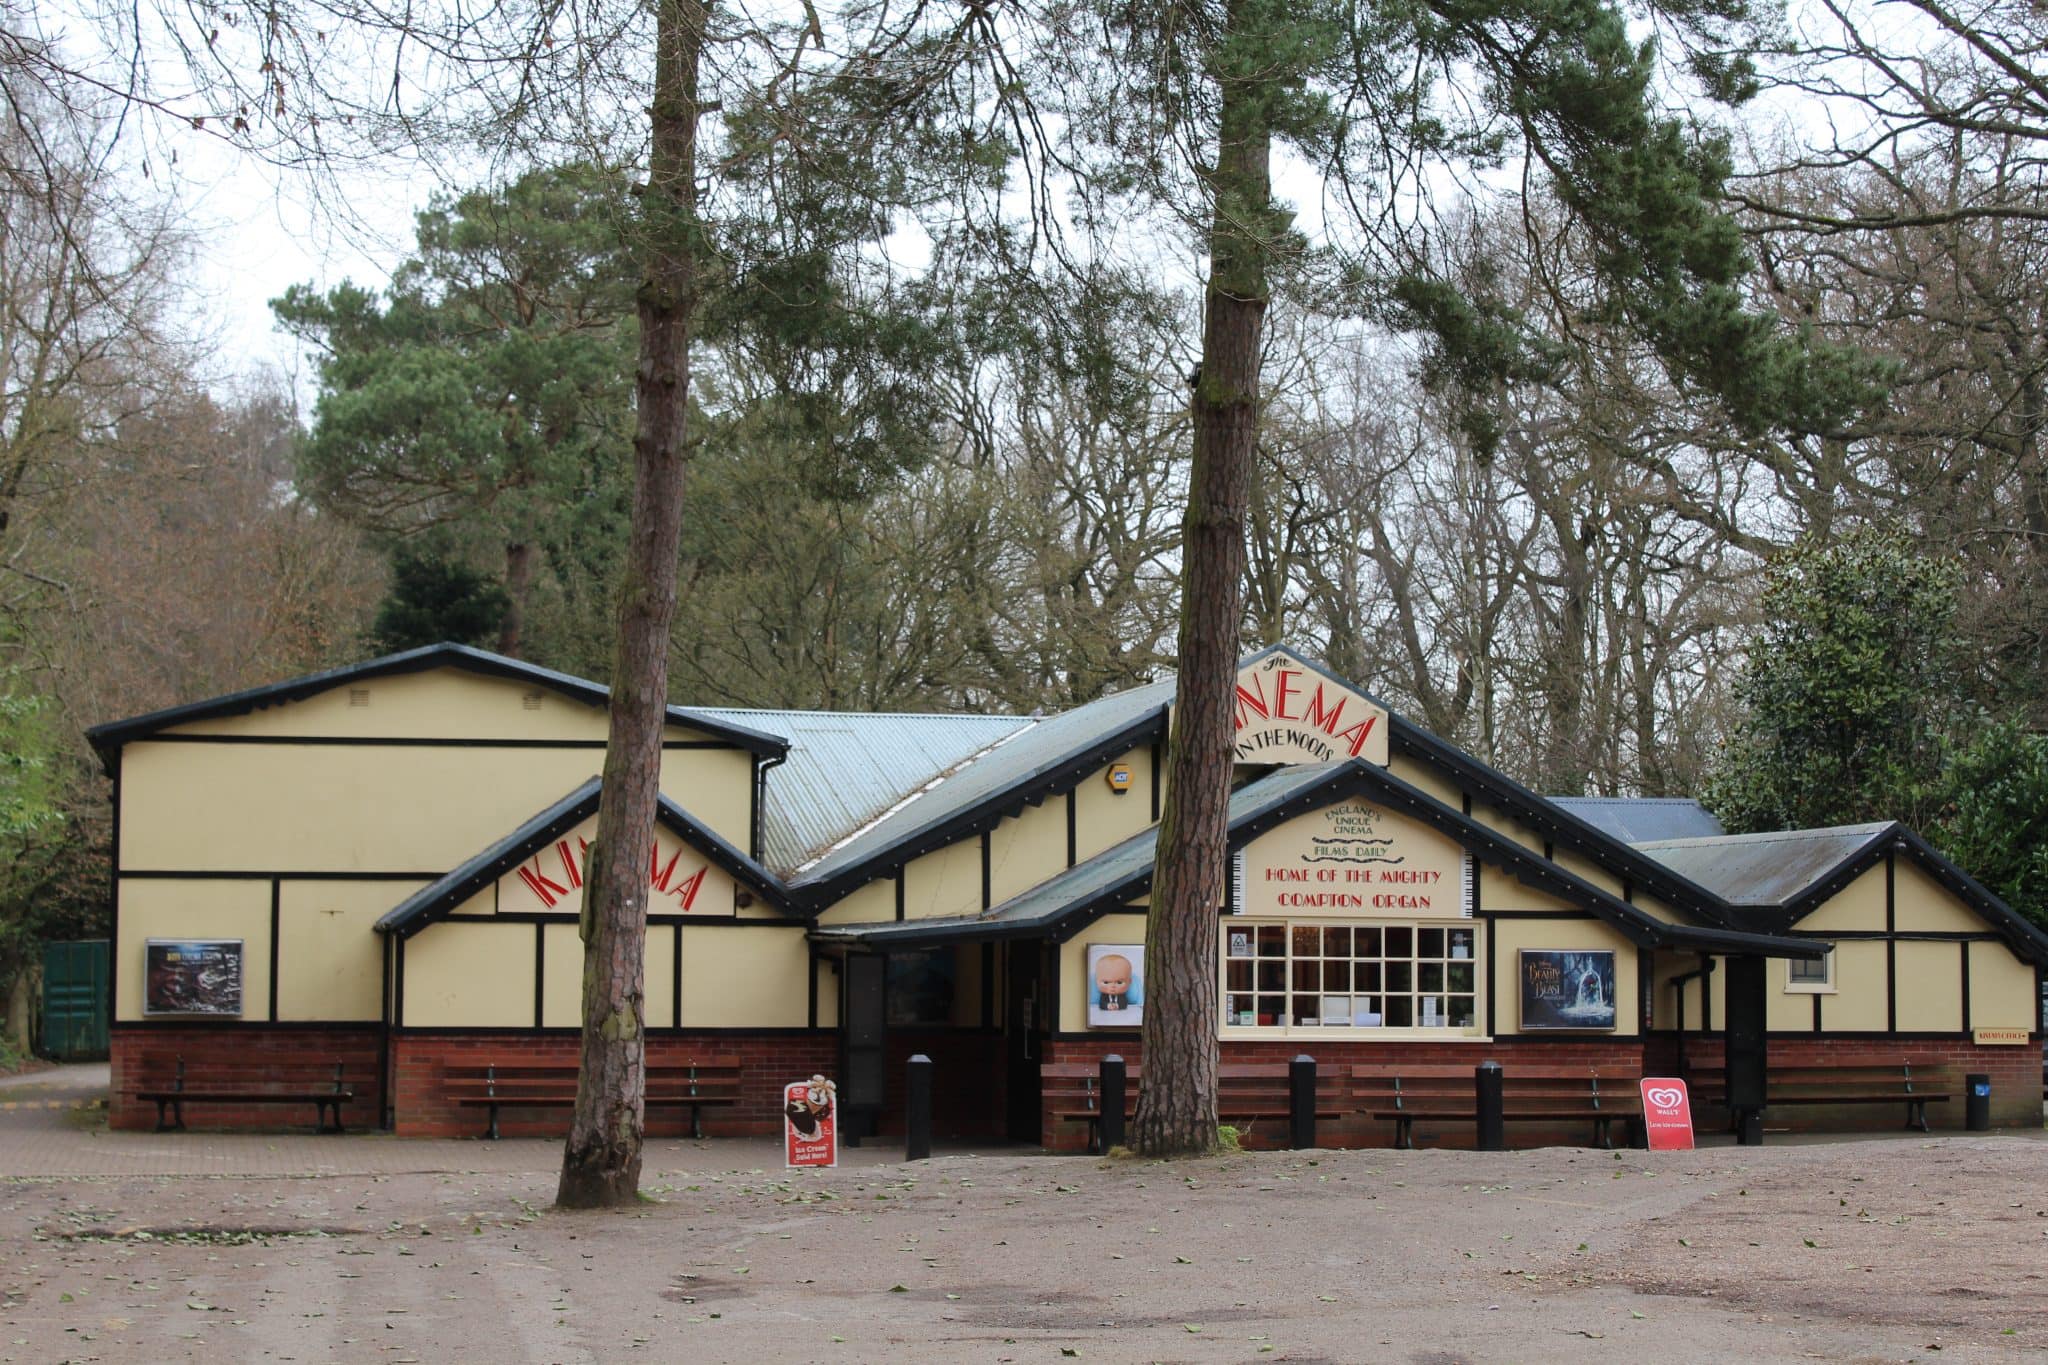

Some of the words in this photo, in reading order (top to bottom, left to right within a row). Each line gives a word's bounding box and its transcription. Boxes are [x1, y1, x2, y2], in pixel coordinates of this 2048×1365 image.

[1262, 655, 1292, 671] The
[1234, 669, 1377, 757] NEMA
[1234, 738, 1254, 761] IN
[1253, 728, 1283, 750] THE
[1287, 729, 1334, 762] WOODS
[1325, 804, 1383, 822] ENGLAND'S
[1335, 816, 1371, 826] UNIQUE
[1333, 826, 1373, 835] CINEMA
[1314, 846, 1349, 856] FILMS
[1355, 846, 1388, 857] DAILY
[517, 835, 708, 912] KIMA
[1265, 868, 1310, 882] HOME
[1316, 869, 1338, 882] OF
[1345, 870, 1373, 883] THE
[1379, 870, 1442, 884] MIGHTY
[1278, 893, 1362, 908] COMPTON
[1372, 894, 1431, 909] ORGAN
